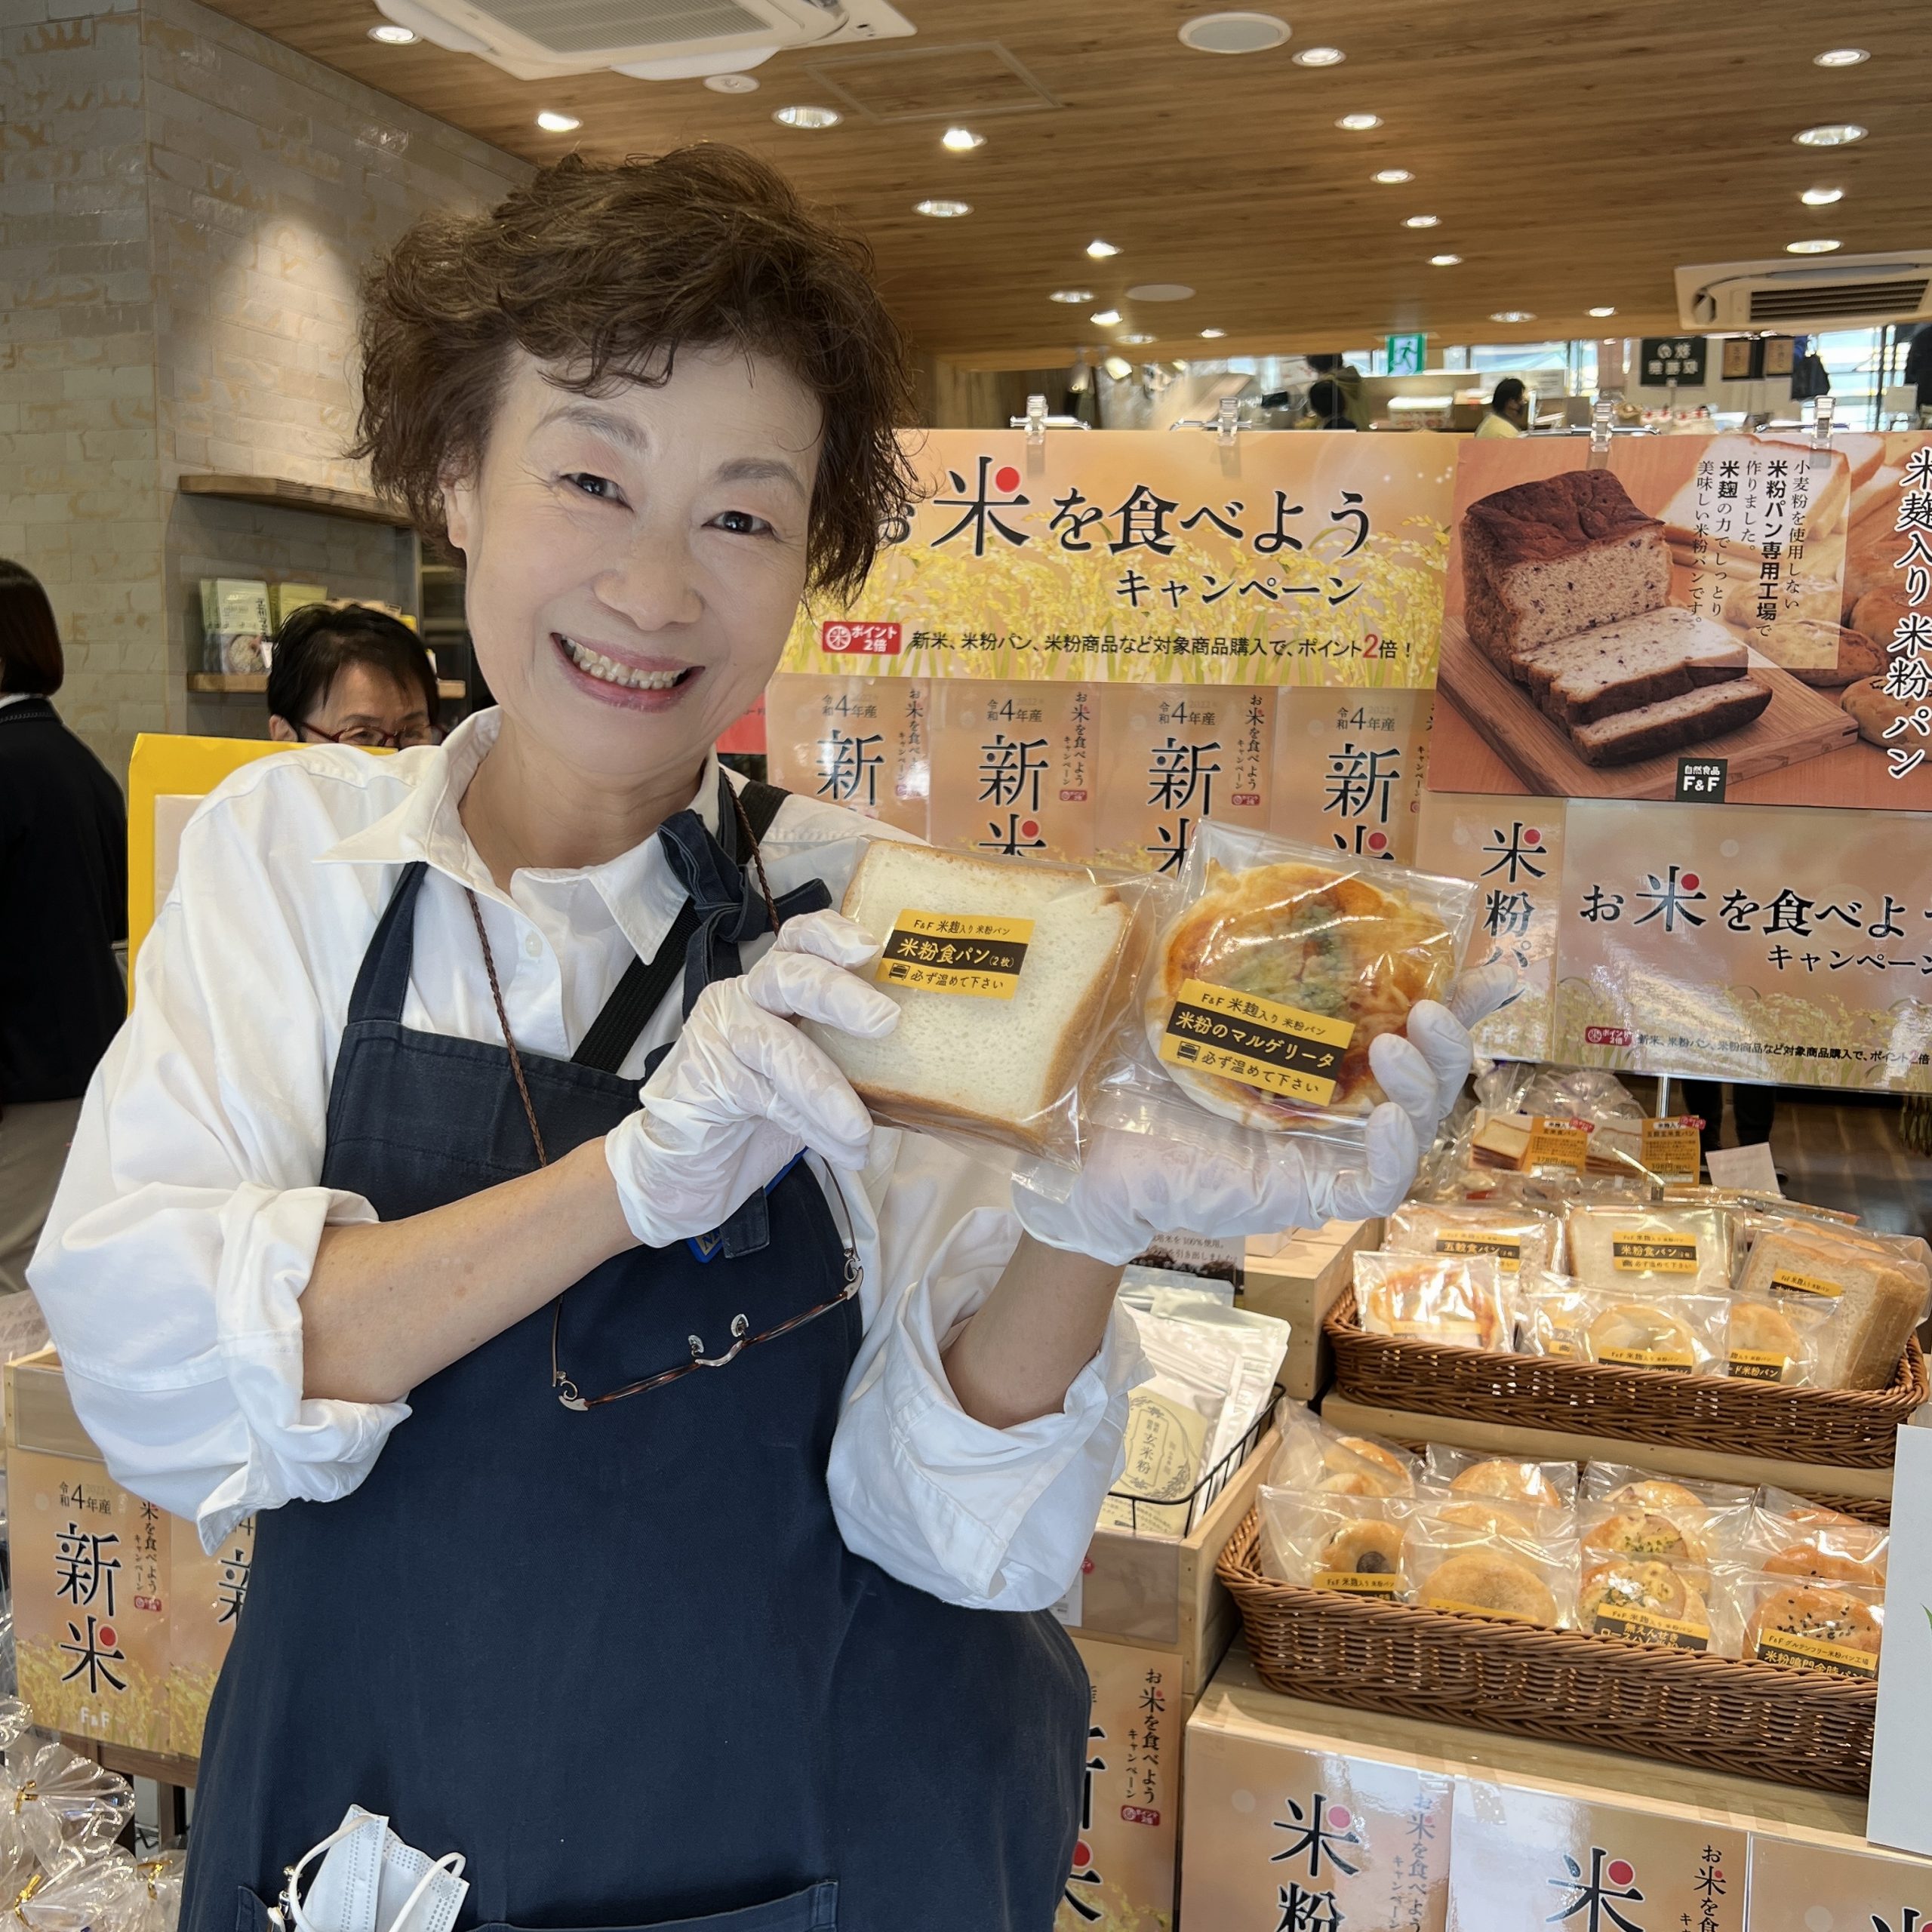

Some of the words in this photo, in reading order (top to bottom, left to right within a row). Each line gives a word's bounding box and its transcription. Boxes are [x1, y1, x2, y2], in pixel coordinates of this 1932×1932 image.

[1711, 460, 1740, 617] 米麹の力でしっとり
[1740, 460, 1762, 552] 作りました。
[1786, 459, 1811, 610] 小麦粉を使用しない
[1755, 460, 1789, 637] 米粉パン専用工場で
[1116, 570, 1364, 608] キャンペーン
[1884, 448, 1932, 777] 米麹入り米粉パン
[851, 625, 897, 638] ポイント
[863, 639, 888, 653] 2倍
[817, 729, 885, 812] 新
[1071, 691, 1090, 786] お米を食べよう
[1245, 694, 1265, 791] お米を食べよう
[1683, 776, 1720, 792] F&F
[914, 919, 935, 931] F&F
[936, 920, 974, 934] 米麹入り
[976, 925, 1011, 936] 米粉パン
[1481, 822, 1546, 1012] 米粉パ
[1580, 866, 1932, 938] お米を食べよ
[911, 969, 1004, 989] 必ず温めて下さい
[1175, 1011, 1335, 1069] 米粉のマルゲリータ
[1201, 993, 1225, 1006] F&F
[1227, 998, 1278, 1023] 米麹入り
[1282, 1017, 1326, 1036] 米粉パン
[1201, 1051, 1319, 1093] 必ず温めて下さい
[1135, 1433, 1159, 1475] 玄米粉
[60, 1481, 112, 1514] 令和4年産
[56, 1523, 127, 1694] 新米
[80, 1707, 110, 1728] F&F
[1139, 1668, 1165, 1804] お米を食べよう
[1126, 1729, 1138, 1798] キャンペーン
[1271, 1793, 1359, 1932] 米粉
